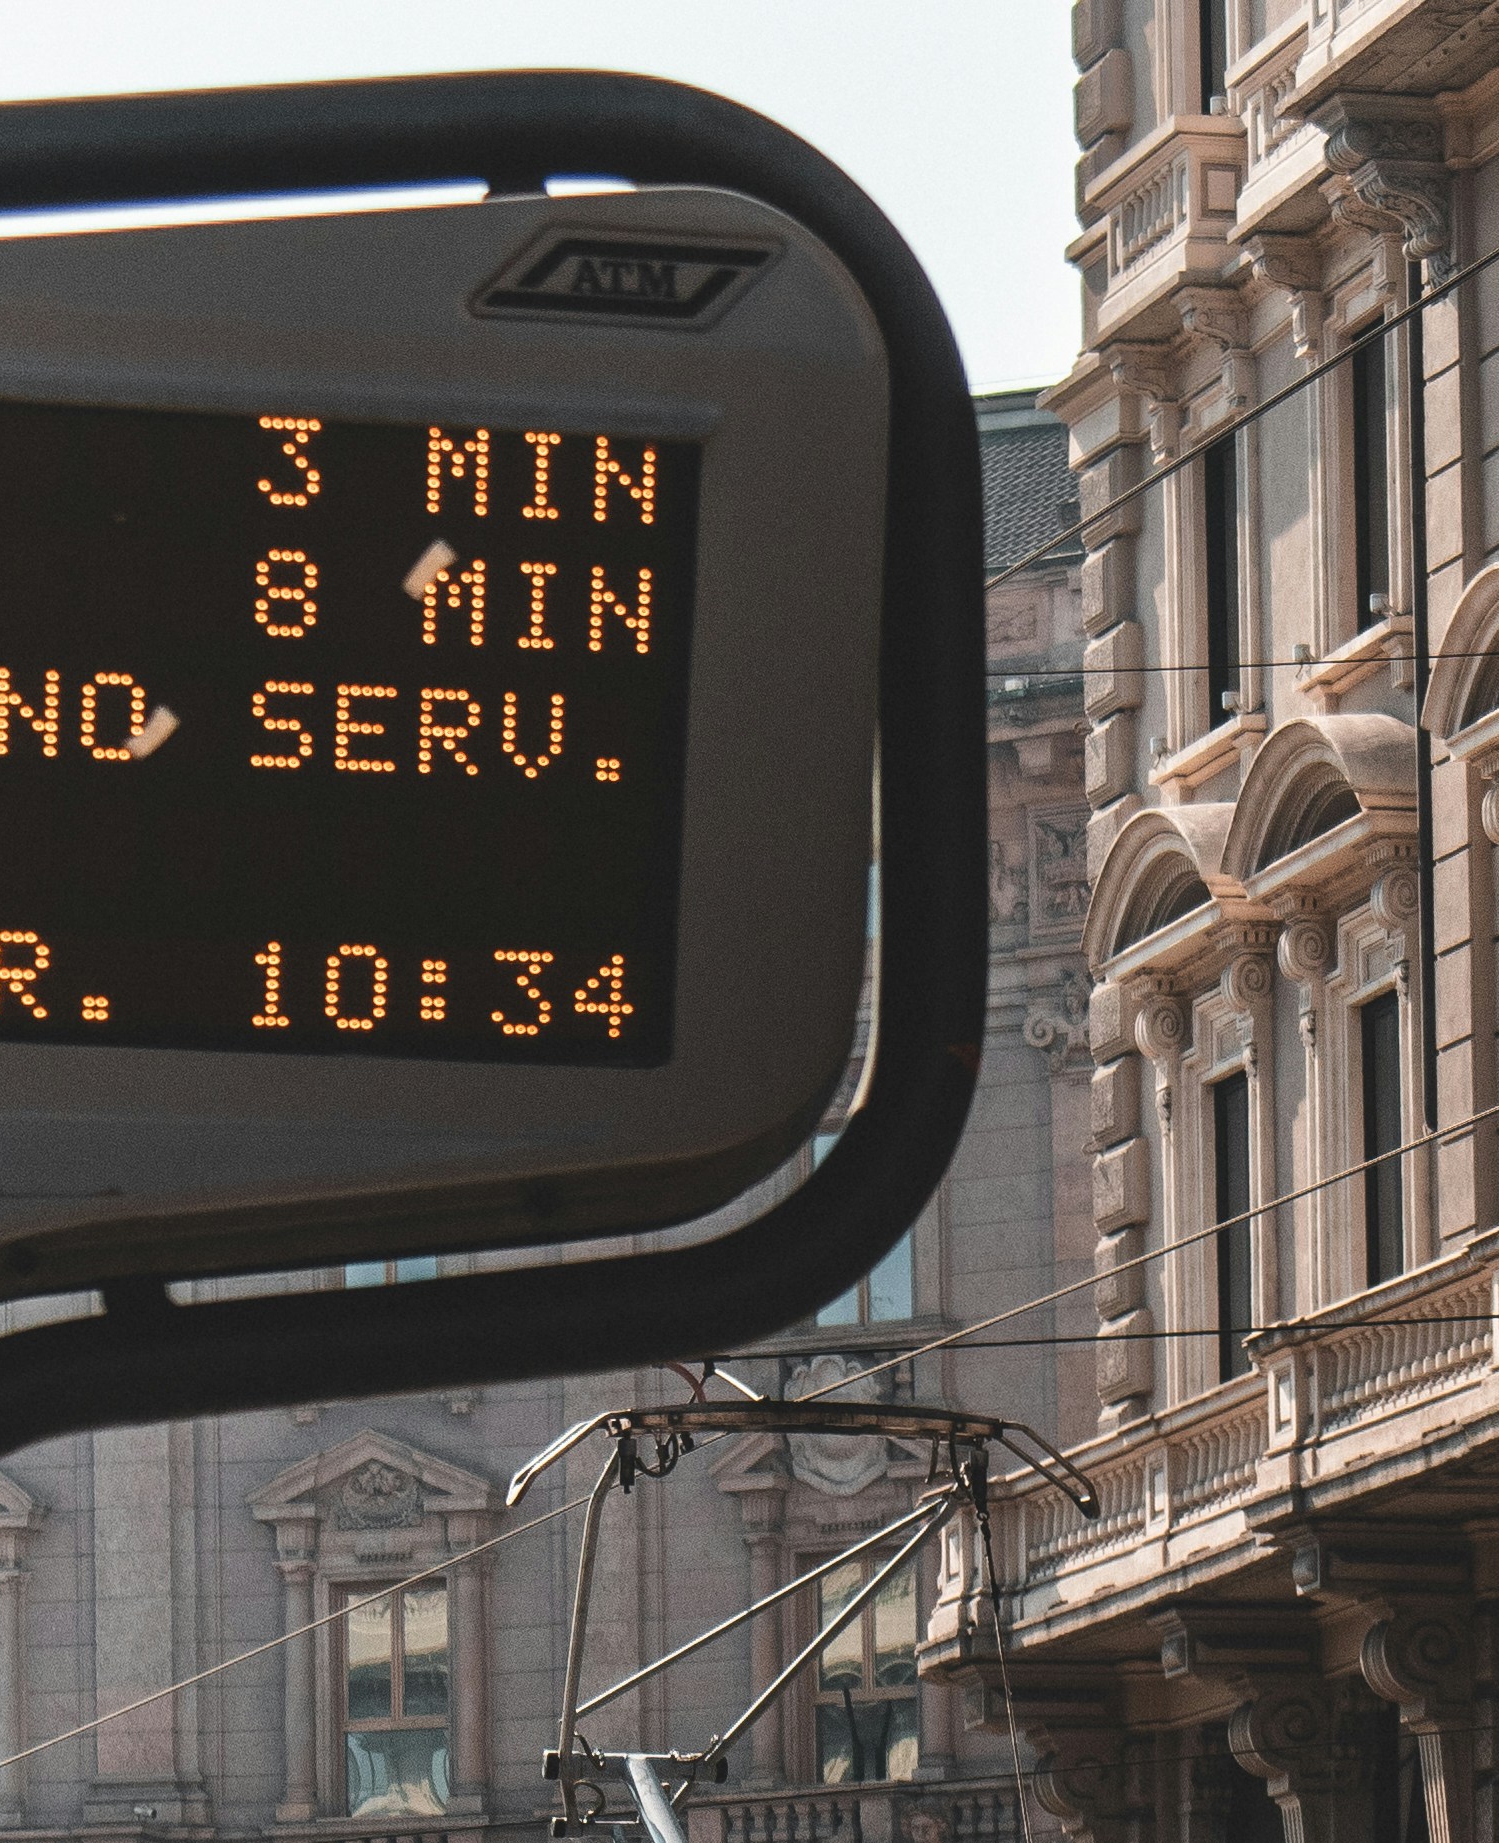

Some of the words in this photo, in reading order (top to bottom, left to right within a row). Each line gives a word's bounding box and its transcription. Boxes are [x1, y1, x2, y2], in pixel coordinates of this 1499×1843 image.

[571, 257, 679, 301] ATM
[256, 415, 323, 508] 3
[426, 427, 658, 526] MIN
[255, 548, 320, 639] 8
[422, 557, 653, 656] MIN
[251, 680, 623, 784] SERV.
[253, 940, 635, 1040] 10:34
